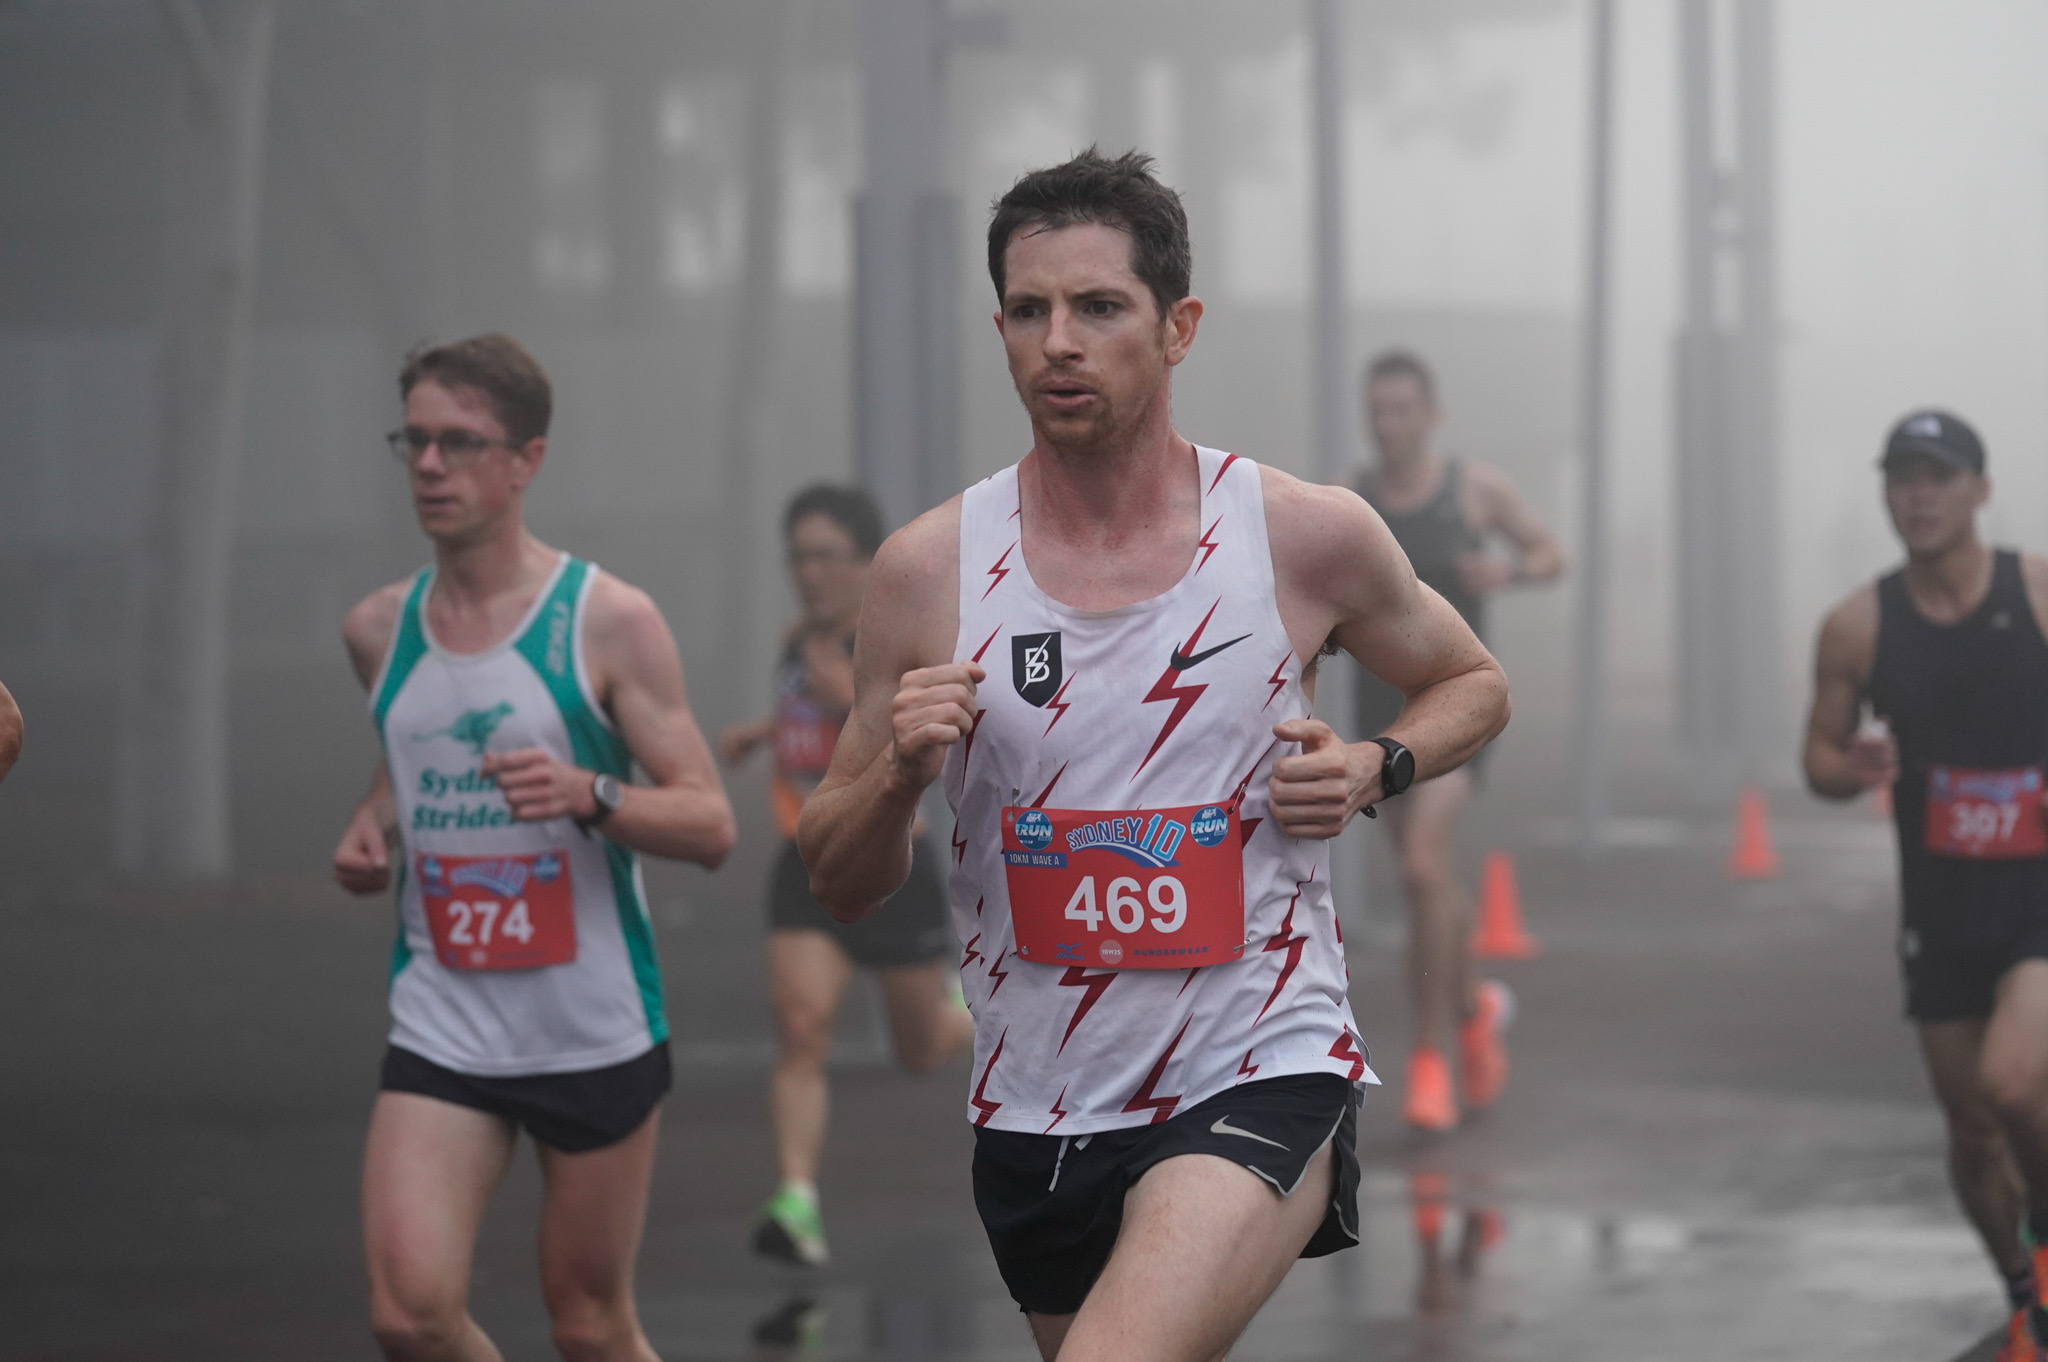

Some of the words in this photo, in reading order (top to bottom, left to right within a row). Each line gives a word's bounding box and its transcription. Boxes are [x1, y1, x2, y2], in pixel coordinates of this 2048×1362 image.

[419, 767, 497, 798] Sydn
[1066, 816, 1143, 850] SYDNEY
[1140, 813, 1186, 862] 10
[1009, 854, 1029, 864] 10KM
[1032, 855, 1052, 865] WAVE
[1054, 856, 1060, 866] A
[447, 900, 535, 945] 274
[1064, 875, 1187, 934] 469
[1134, 946, 1209, 956] RUNDERWEAR
